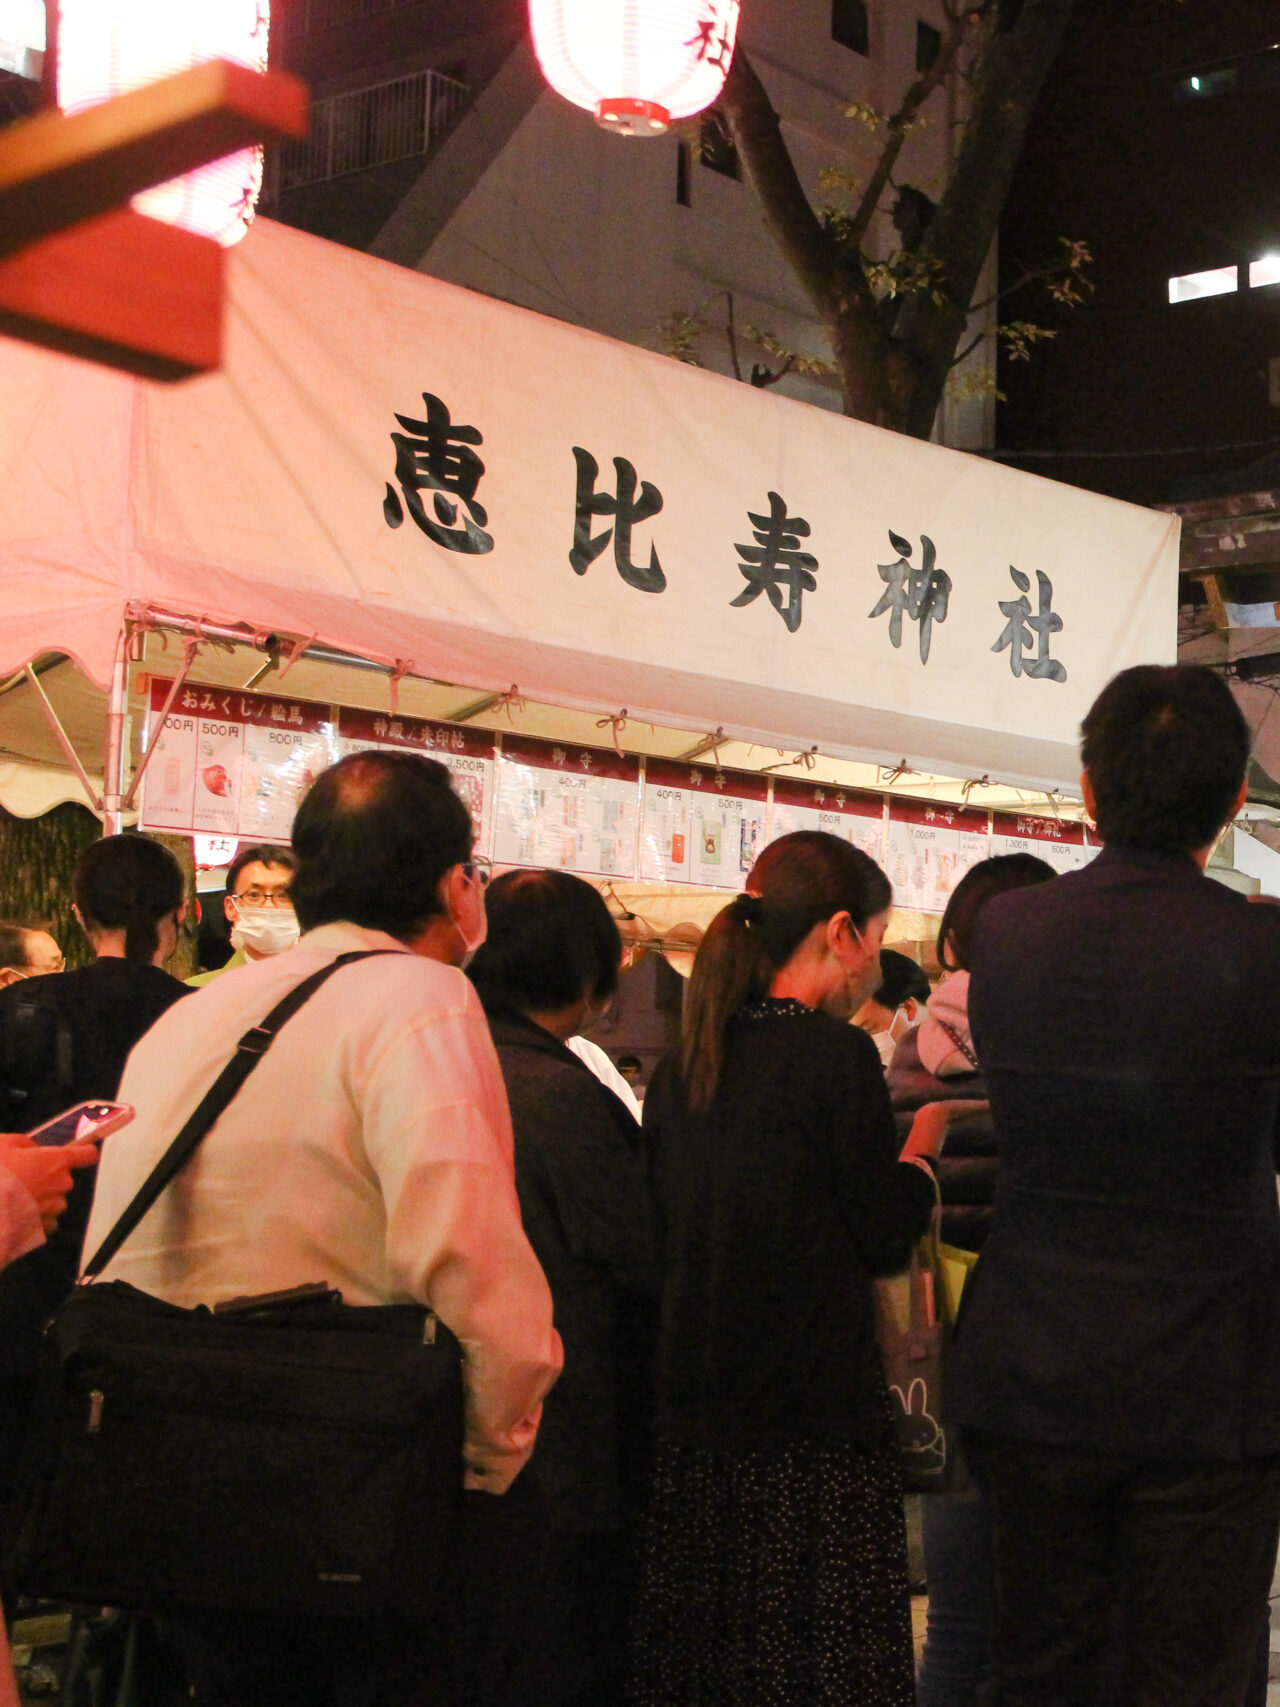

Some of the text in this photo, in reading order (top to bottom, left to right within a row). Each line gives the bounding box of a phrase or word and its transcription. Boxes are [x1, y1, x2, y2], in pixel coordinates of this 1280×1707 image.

[383, 391, 1067, 683] 恵比寿神社
[201, 722, 240, 739] 500円
[268, 732, 304, 746] 800円
[818, 813, 841, 825] 500円
[207, 838, 230, 853] 社
